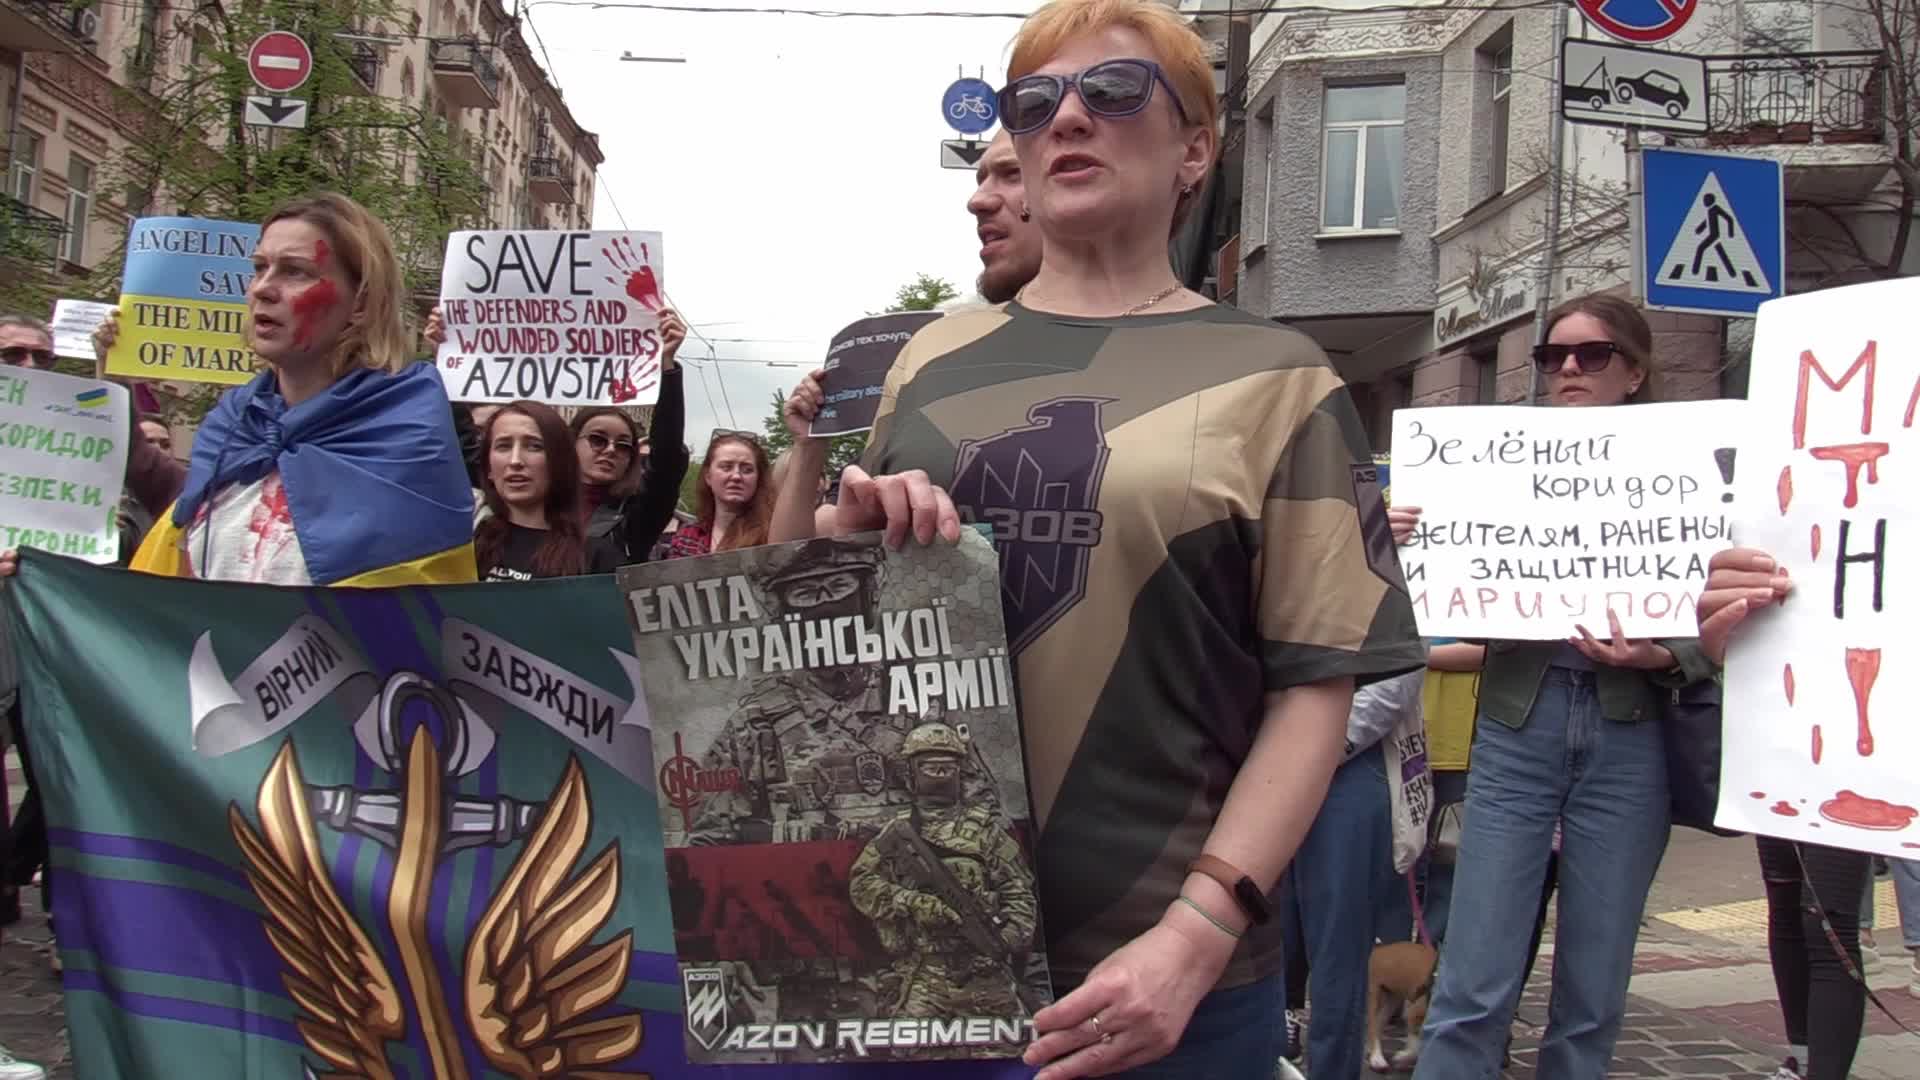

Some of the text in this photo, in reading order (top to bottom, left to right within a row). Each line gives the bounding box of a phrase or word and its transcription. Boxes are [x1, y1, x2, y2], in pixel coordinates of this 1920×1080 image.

[134, 229, 255, 258] ANGELIN
[466, 233, 593, 295] SAVE
[134, 303, 190, 329] THE
[444, 299, 627, 325] THE DEFENDERS AND
[139, 342, 177, 366] OF
[456, 328, 659, 355] WOUNDED SOLDIERS
[446, 356, 633, 399] OF AZOVSTAL
[1402, 421, 1616, 468] Зелёный
[1600, 514, 1733, 547] РАНЕНЫ
[630, 574, 760, 634] ЕЛІТА
[674, 598, 953, 681] УКРАЇНСЬКОЇ
[254, 625, 615, 745] ВІРНИЙ ЗАВЖДИ
[888, 647, 1010, 719] АРМІЇ
[720, 1021, 824, 1050] AZOV
